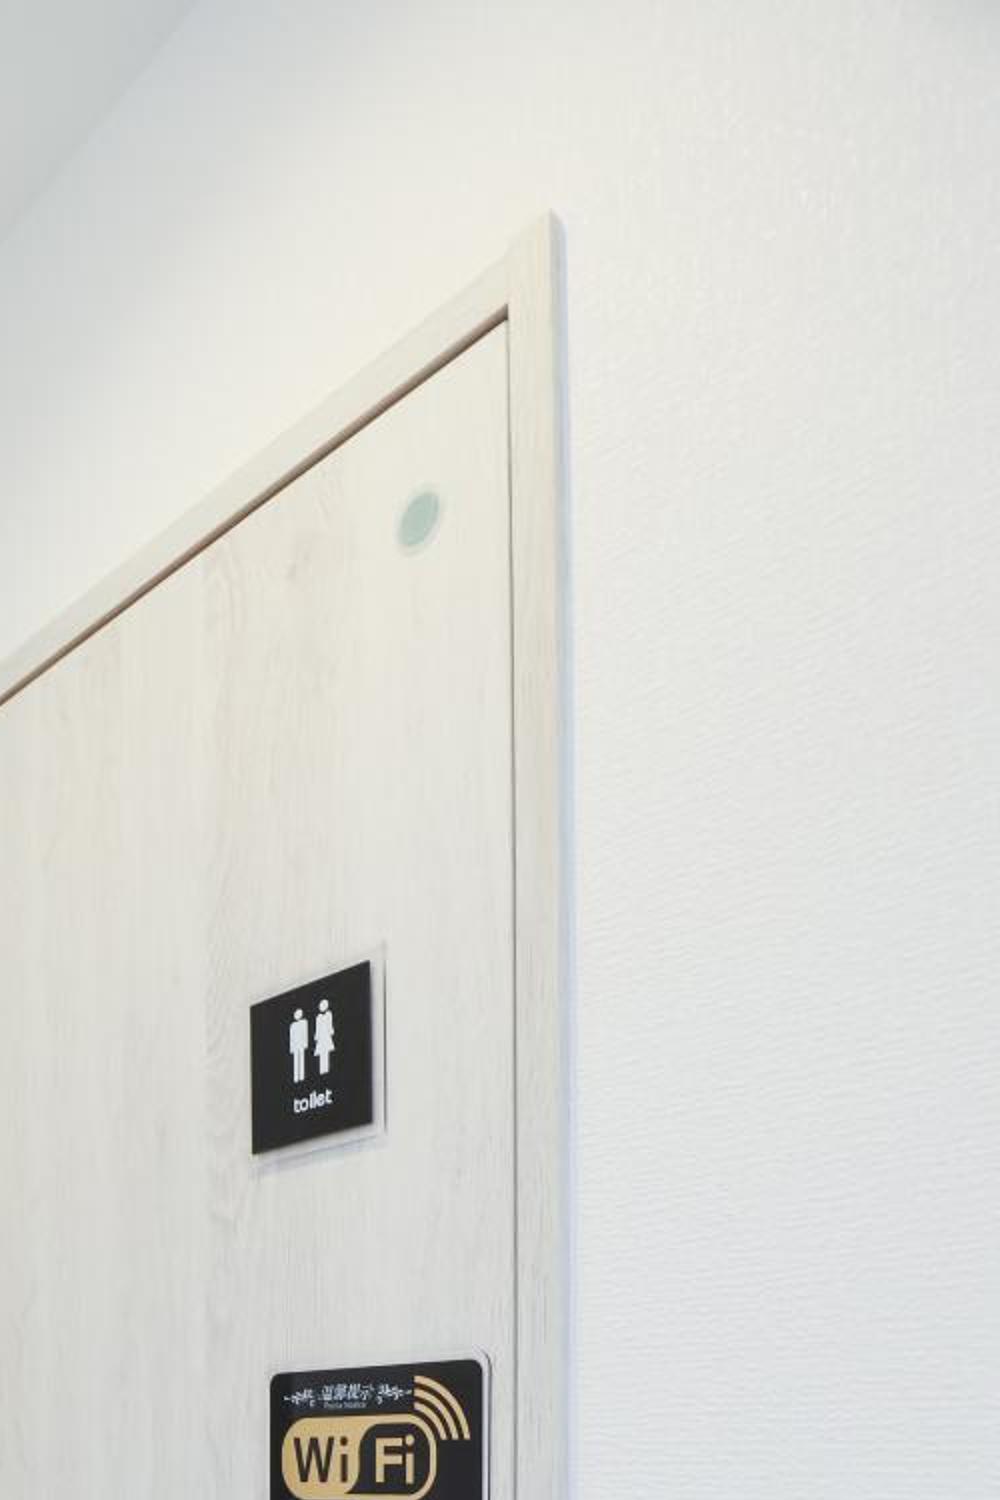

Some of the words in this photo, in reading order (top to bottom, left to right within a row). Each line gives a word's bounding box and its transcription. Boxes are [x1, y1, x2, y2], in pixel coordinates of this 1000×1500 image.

[293, 1089, 333, 1113] toilet
[293, 1436, 349, 1483] Wi
[375, 1433, 415, 1485] Fi
